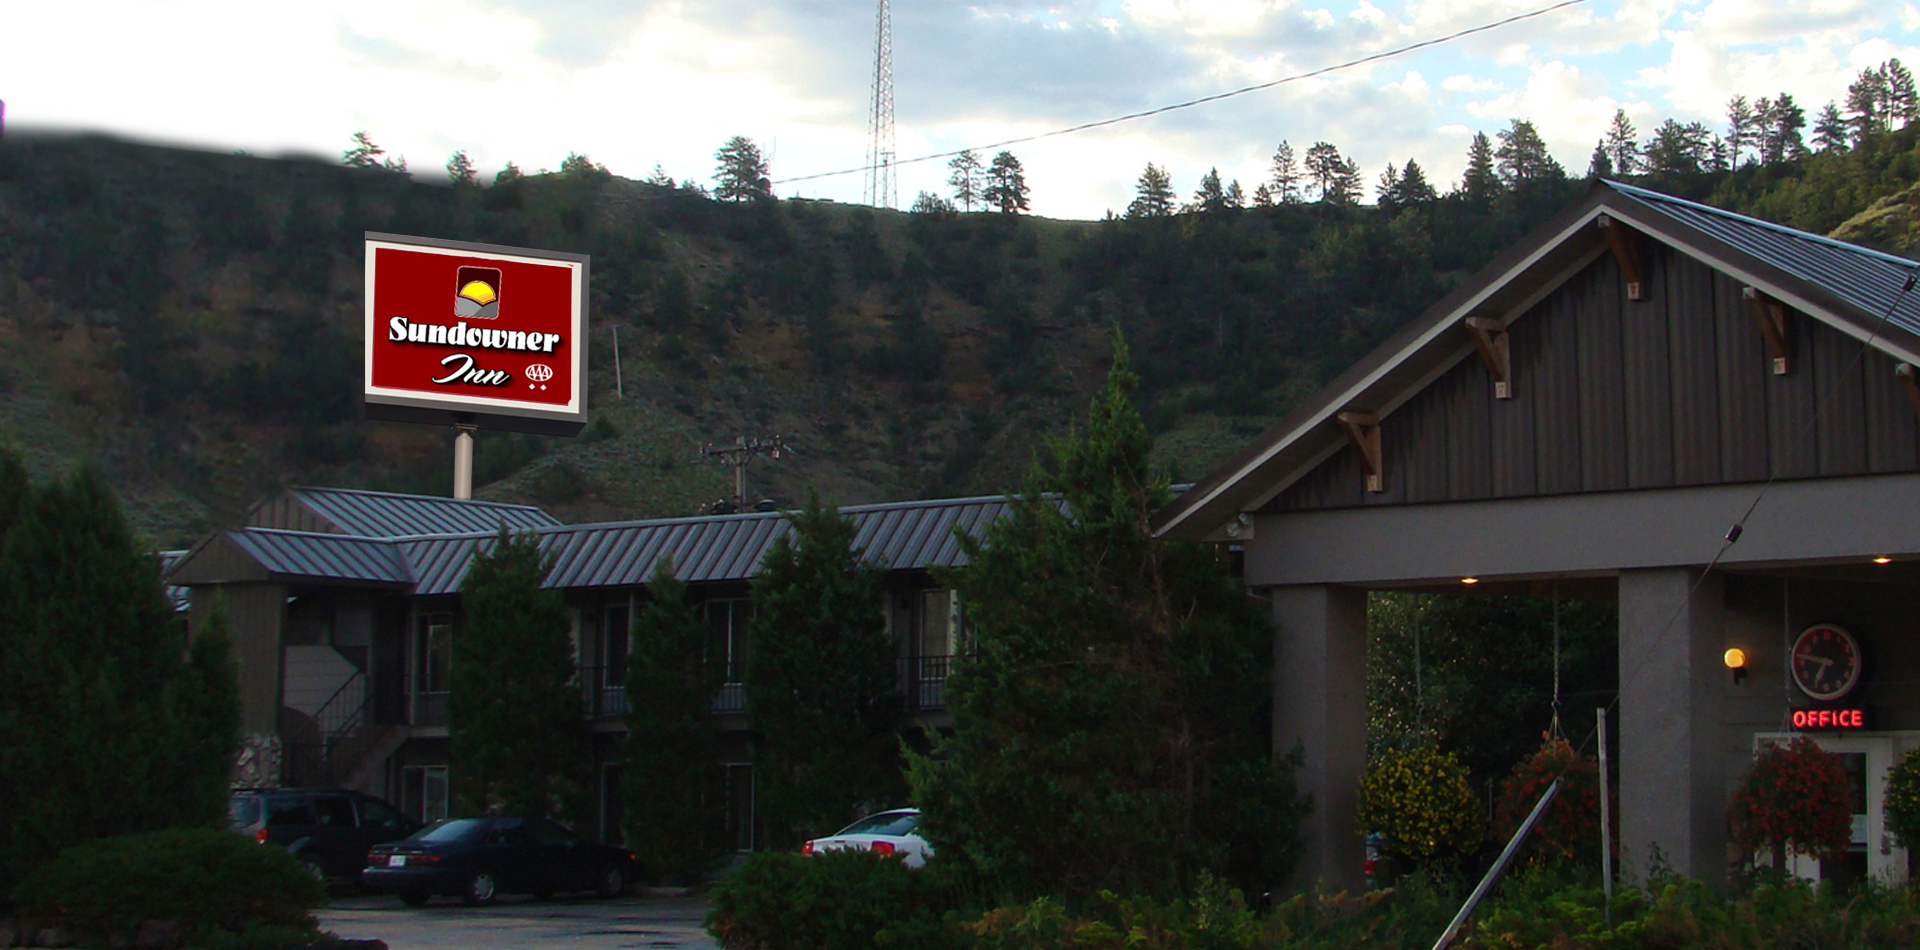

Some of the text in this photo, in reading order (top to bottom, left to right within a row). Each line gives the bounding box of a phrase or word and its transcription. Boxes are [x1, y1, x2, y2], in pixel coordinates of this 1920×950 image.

[389, 316, 560, 352] Sundowner
[432, 353, 511, 386] Inn
[527, 364, 552, 381] AAA
[1792, 709, 1864, 728] OFFICE
